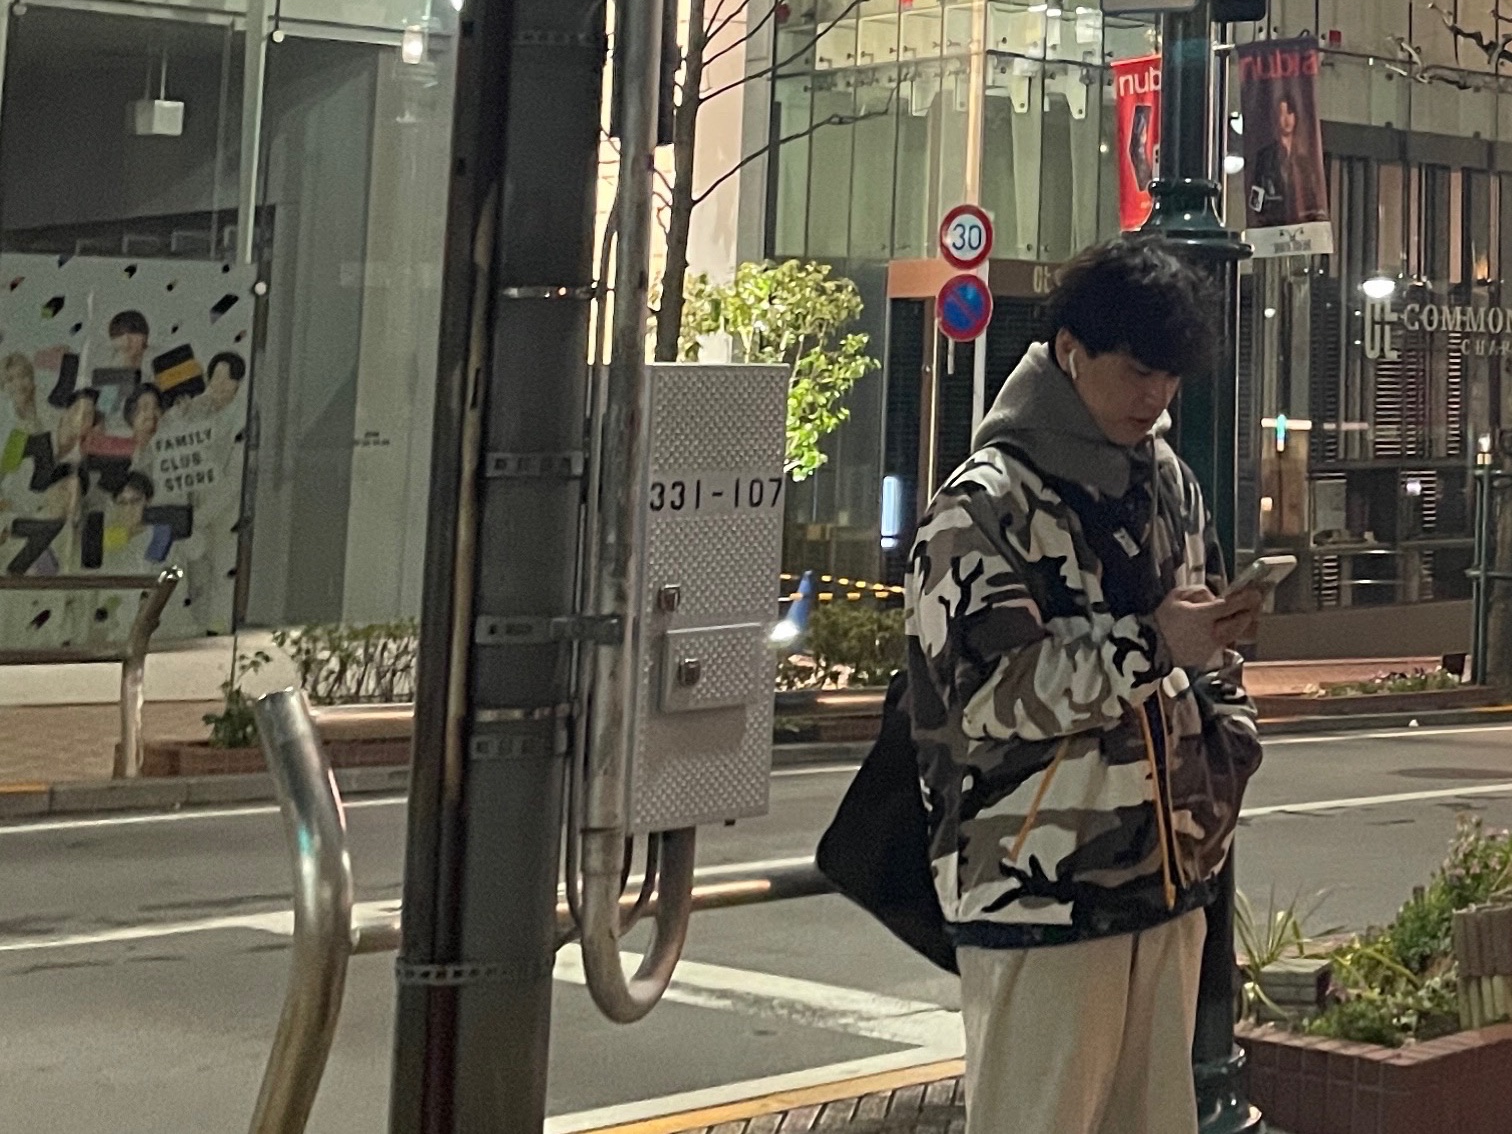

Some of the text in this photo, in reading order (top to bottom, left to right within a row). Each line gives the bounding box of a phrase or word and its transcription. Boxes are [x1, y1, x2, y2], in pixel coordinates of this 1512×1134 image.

[1240, 48, 1318, 80] nubia
[1119, 67, 1161, 96] nub
[952, 224, 982, 251] 30
[155, 428, 212, 452] FAMILY
[160, 452, 201, 473] CLUB
[165, 469, 215, 492] STORE
[650, 477, 782, 512] 331-107
